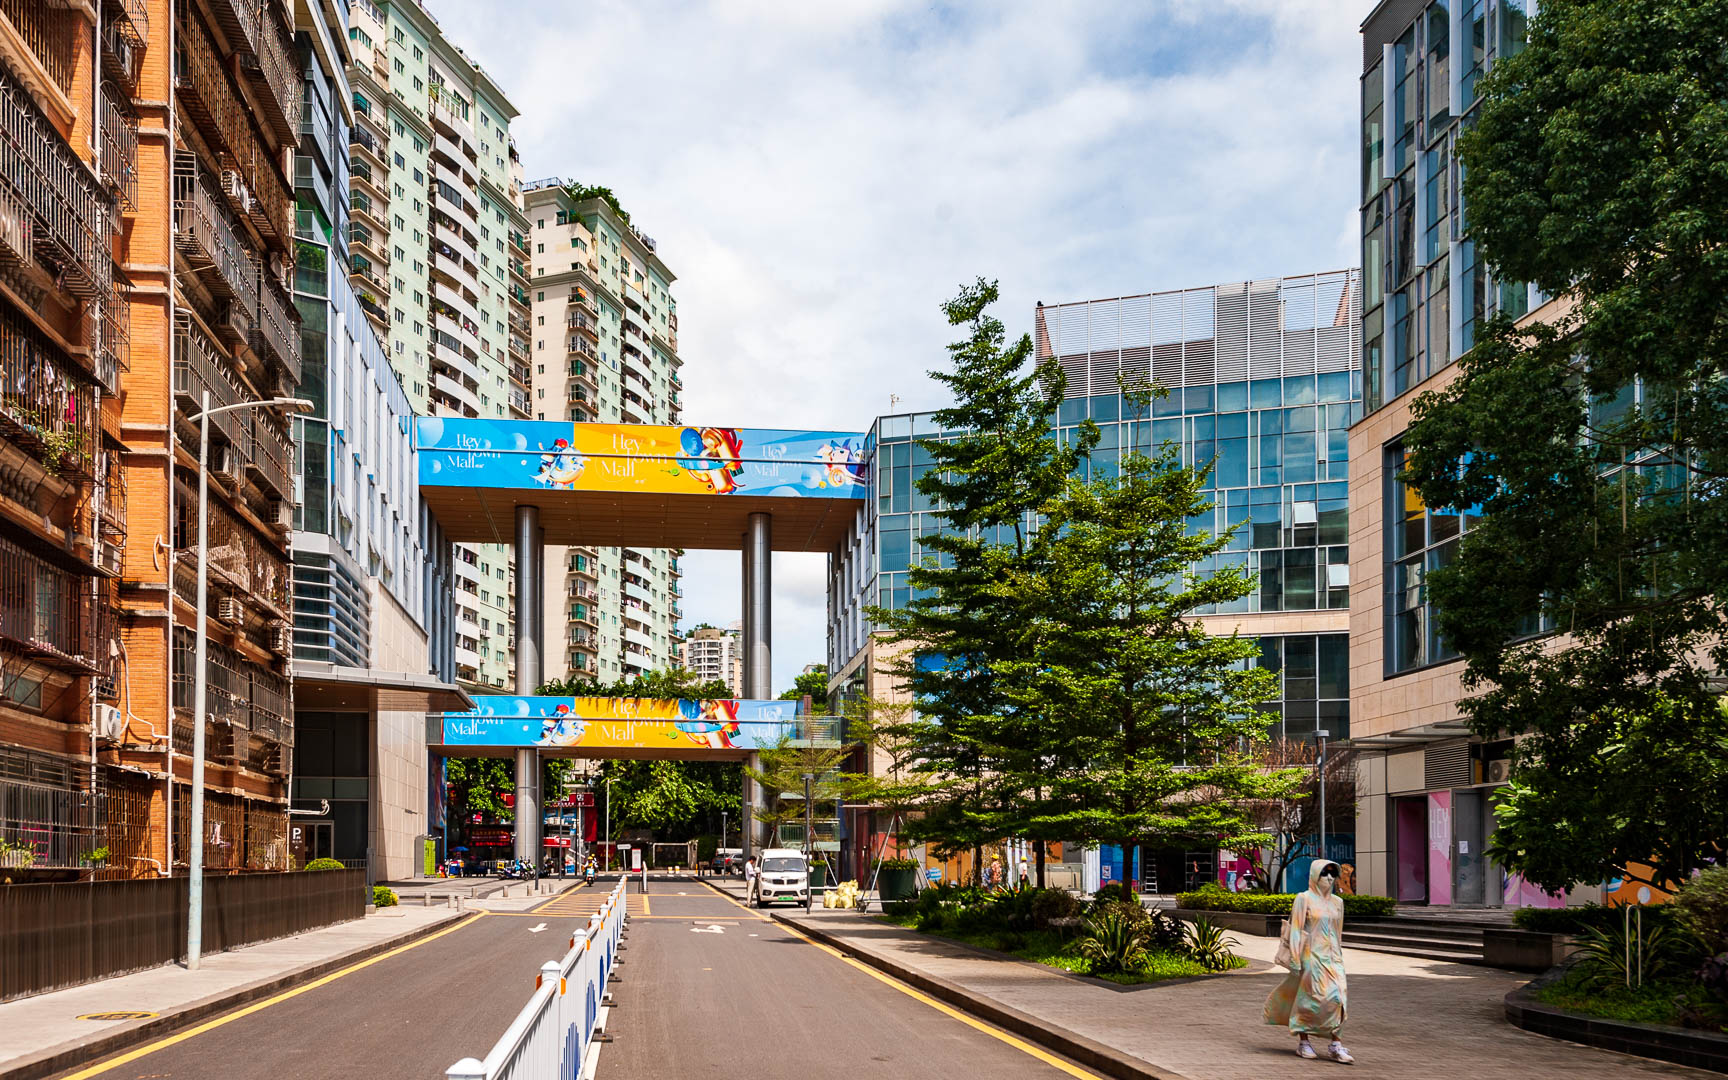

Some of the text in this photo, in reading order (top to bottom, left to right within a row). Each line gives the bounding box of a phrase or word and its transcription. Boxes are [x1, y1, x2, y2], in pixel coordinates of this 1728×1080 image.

[612, 433, 643, 455] Hey
[447, 455, 475, 469] Mall
[601, 460, 635, 478] Mall
[451, 722, 478, 736] Mall
[601, 724, 635, 741] Mall
[1429, 807, 1449, 840] HEY
[293, 828, 302, 840] P
[1331, 843, 1355, 860] MALL
